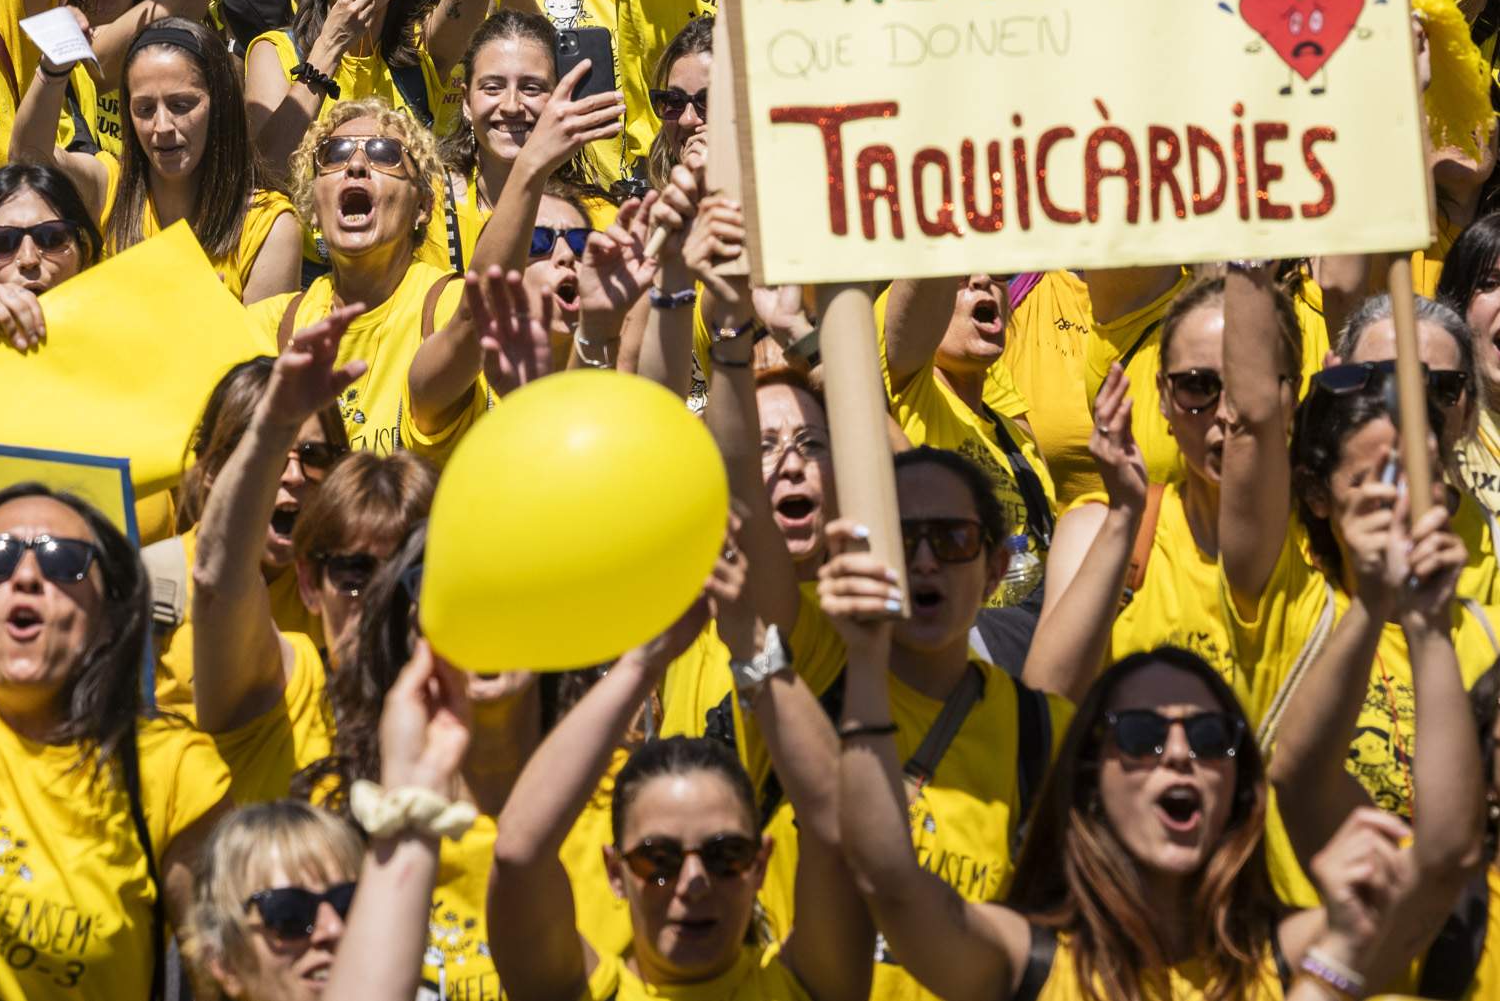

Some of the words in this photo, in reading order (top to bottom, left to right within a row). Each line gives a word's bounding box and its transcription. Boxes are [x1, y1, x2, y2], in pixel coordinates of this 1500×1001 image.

[766, 27, 854, 81] QUE
[888, 8, 1073, 63] DONEN
[769, 97, 1338, 242] TAQUICÀRDIES
[7, 942, 87, 990] 0-3
